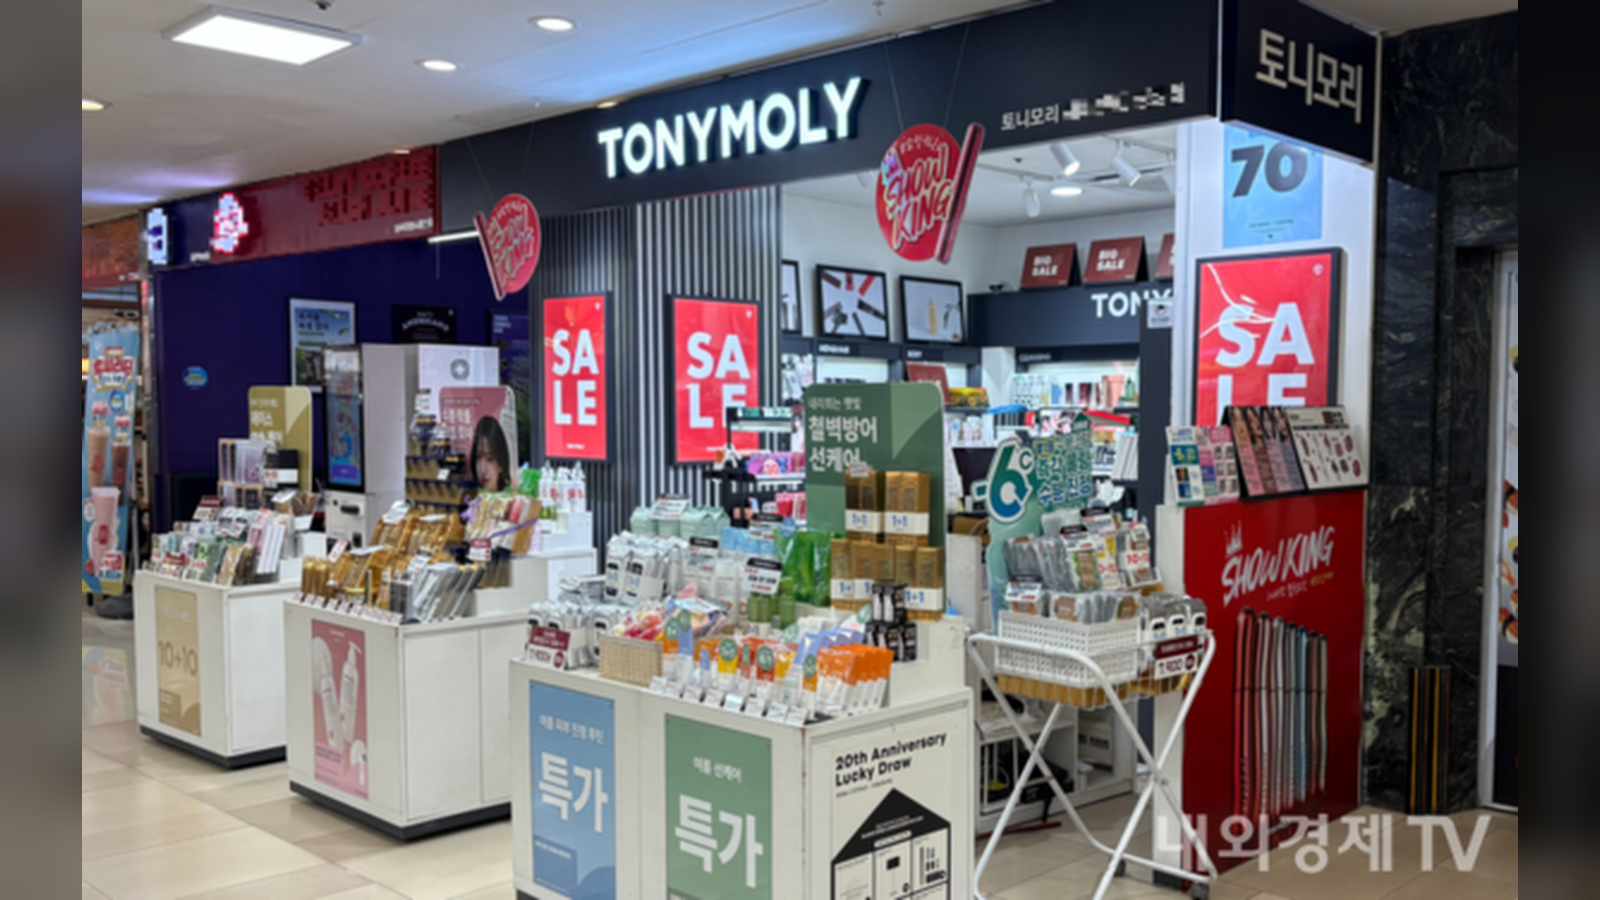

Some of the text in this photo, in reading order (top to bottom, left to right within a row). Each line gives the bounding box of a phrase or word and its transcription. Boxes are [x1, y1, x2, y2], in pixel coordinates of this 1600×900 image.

[1255, 28, 1363, 124] 토니모리
[598, 76, 862, 178] TONYMOLY
[1001, 103, 1060, 131] 토니모리
[882, 142, 950, 220] SHOW
[1231, 141, 1308, 198] 70
[893, 178, 955, 250] KING
[1033, 255, 1052, 266] BIG
[1096, 259, 1125, 271] SALE
[1098, 249, 1118, 261] BIG
[1032, 265, 1058, 277] SALE
[808, 415, 878, 444] 철벽방어
[808, 446, 862, 473] 선케어
[892, 514, 908, 527] 1+1
[1221, 539, 1285, 609] SHOW
[1281, 524, 1336, 583] KING
[906, 590, 925, 603] 1+1
[157, 639, 199, 676] 10+10
[835, 732, 947, 771] 20th Anniversary
[692, 756, 742, 784] 여름 선케어
[835, 757, 912, 787] Lucky Draw
[538, 751, 609, 834] 특가
[675, 793, 764, 889] 특가
